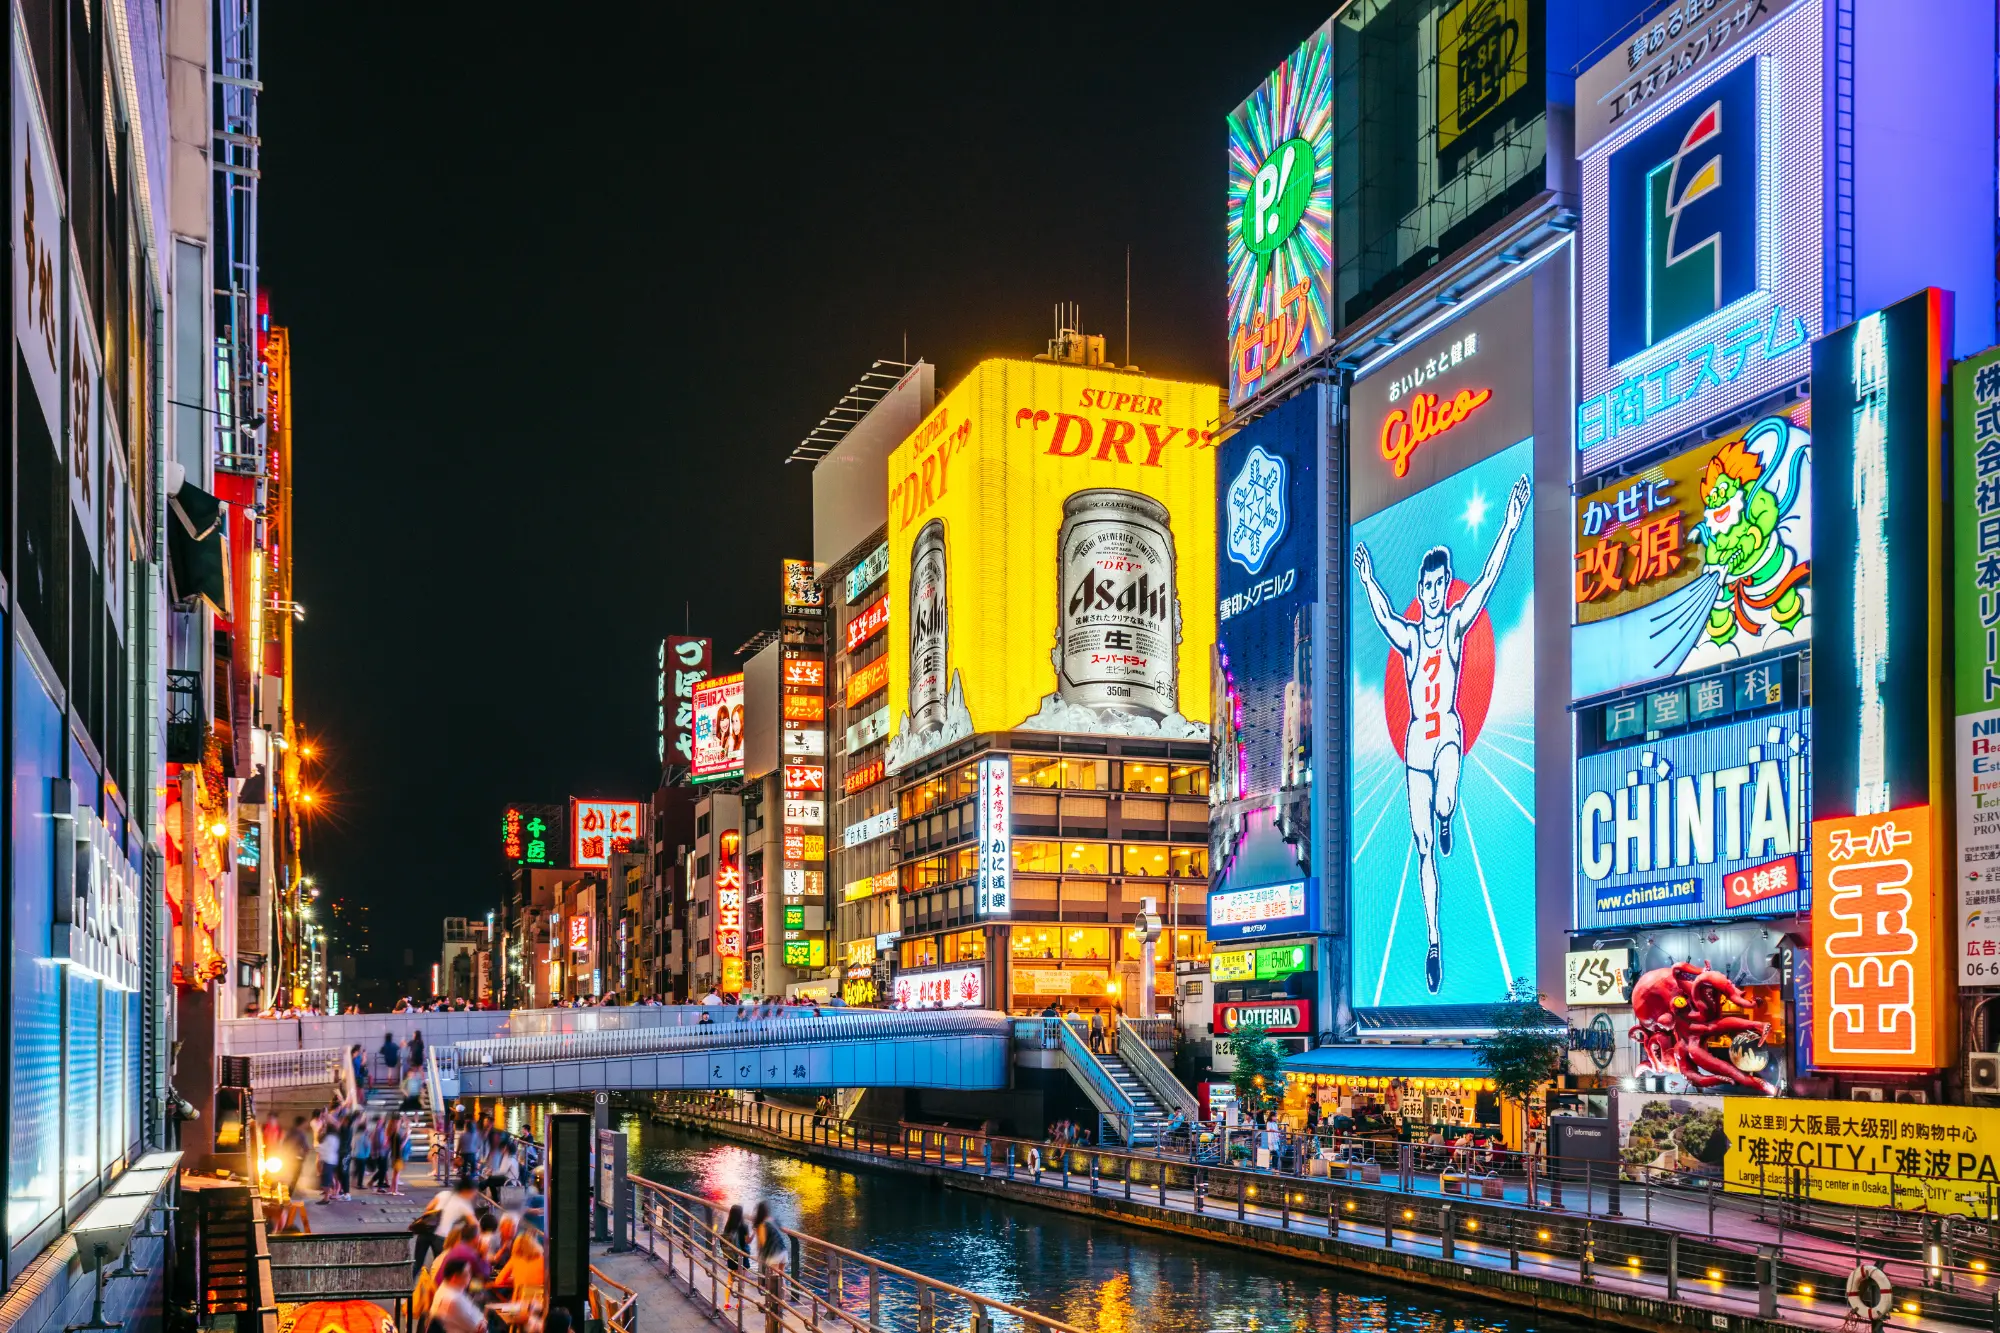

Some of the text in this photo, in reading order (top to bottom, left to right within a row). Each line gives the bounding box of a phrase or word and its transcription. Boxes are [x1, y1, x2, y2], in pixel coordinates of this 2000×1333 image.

[1622, 1, 1753, 115] エステムプラザ
[1237, 275, 1311, 385] ピップ
[1389, 332, 1478, 403] おいしさと健康
[1577, 306, 1808, 451] 日商エステム
[1079, 388, 1164, 417] SUPER
[913, 407, 949, 460] SUPER
[1381, 388, 1493, 478] Glico
[1582, 479, 1672, 537] かぜに
[1974, 362, 2000, 703] 株式会社日本リート
[1079, 532, 1156, 565] ASAHI BREWERIES LIMITED
[1574, 509, 1685, 604] 改源
[1068, 566, 1167, 622] Asahi
[1219, 567, 1295, 621] 雪印メグミルク
[786, 605, 797, 614] 9F
[912, 591, 944, 655] Asahi
[1103, 629, 1133, 651] 生
[785, 651, 799, 659] 8F
[922, 654, 933, 676] 生
[1090, 653, 1148, 668] スーパードライ
[786, 666, 821, 685] 笑笑
[698, 690, 727, 709] 高収入
[785, 686, 799, 694] 7F
[1106, 685, 1132, 698] 350ml
[1422, 648, 1443, 741] グリコ
[1768, 687, 1781, 703] 3F
[785, 706, 822, 718] ダイニング
[785, 721, 799, 729] 6F
[792, 756, 803, 764] 5F
[786, 769, 823, 788] はや
[785, 791, 799, 799] 4F
[787, 804, 821, 819] 白木屋
[992, 784, 1005, 834] 本場の味
[1581, 752, 1801, 882] CHINTAI
[581, 807, 633, 834] かに
[786, 826, 799, 834] 3F
[526, 817, 547, 859] 千房
[1828, 820, 1913, 862] スーパー
[786, 861, 799, 870] 2F
[1752, 865, 1789, 896] 検索
[786, 896, 799, 904] 1F
[715, 865, 740, 957] 大阪王将
[578, 918, 586, 938] ツルハ
[1824, 858, 1919, 1055] 玉出
[1967, 940, 2000, 957] 広告
[1239, 1007, 1294, 1027] LOTTERIA
[712, 1064, 807, 1080] えびす橋
[1403, 1104, 1423, 1118] お好み
[1431, 1103, 1465, 1120] 兄貴の店
[1573, 1130, 1602, 1138] information
[1824, 1179, 1850, 1190] center
[1852, 1182, 1860, 1191] in
[1861, 1181, 1890, 1196] Osaka,
